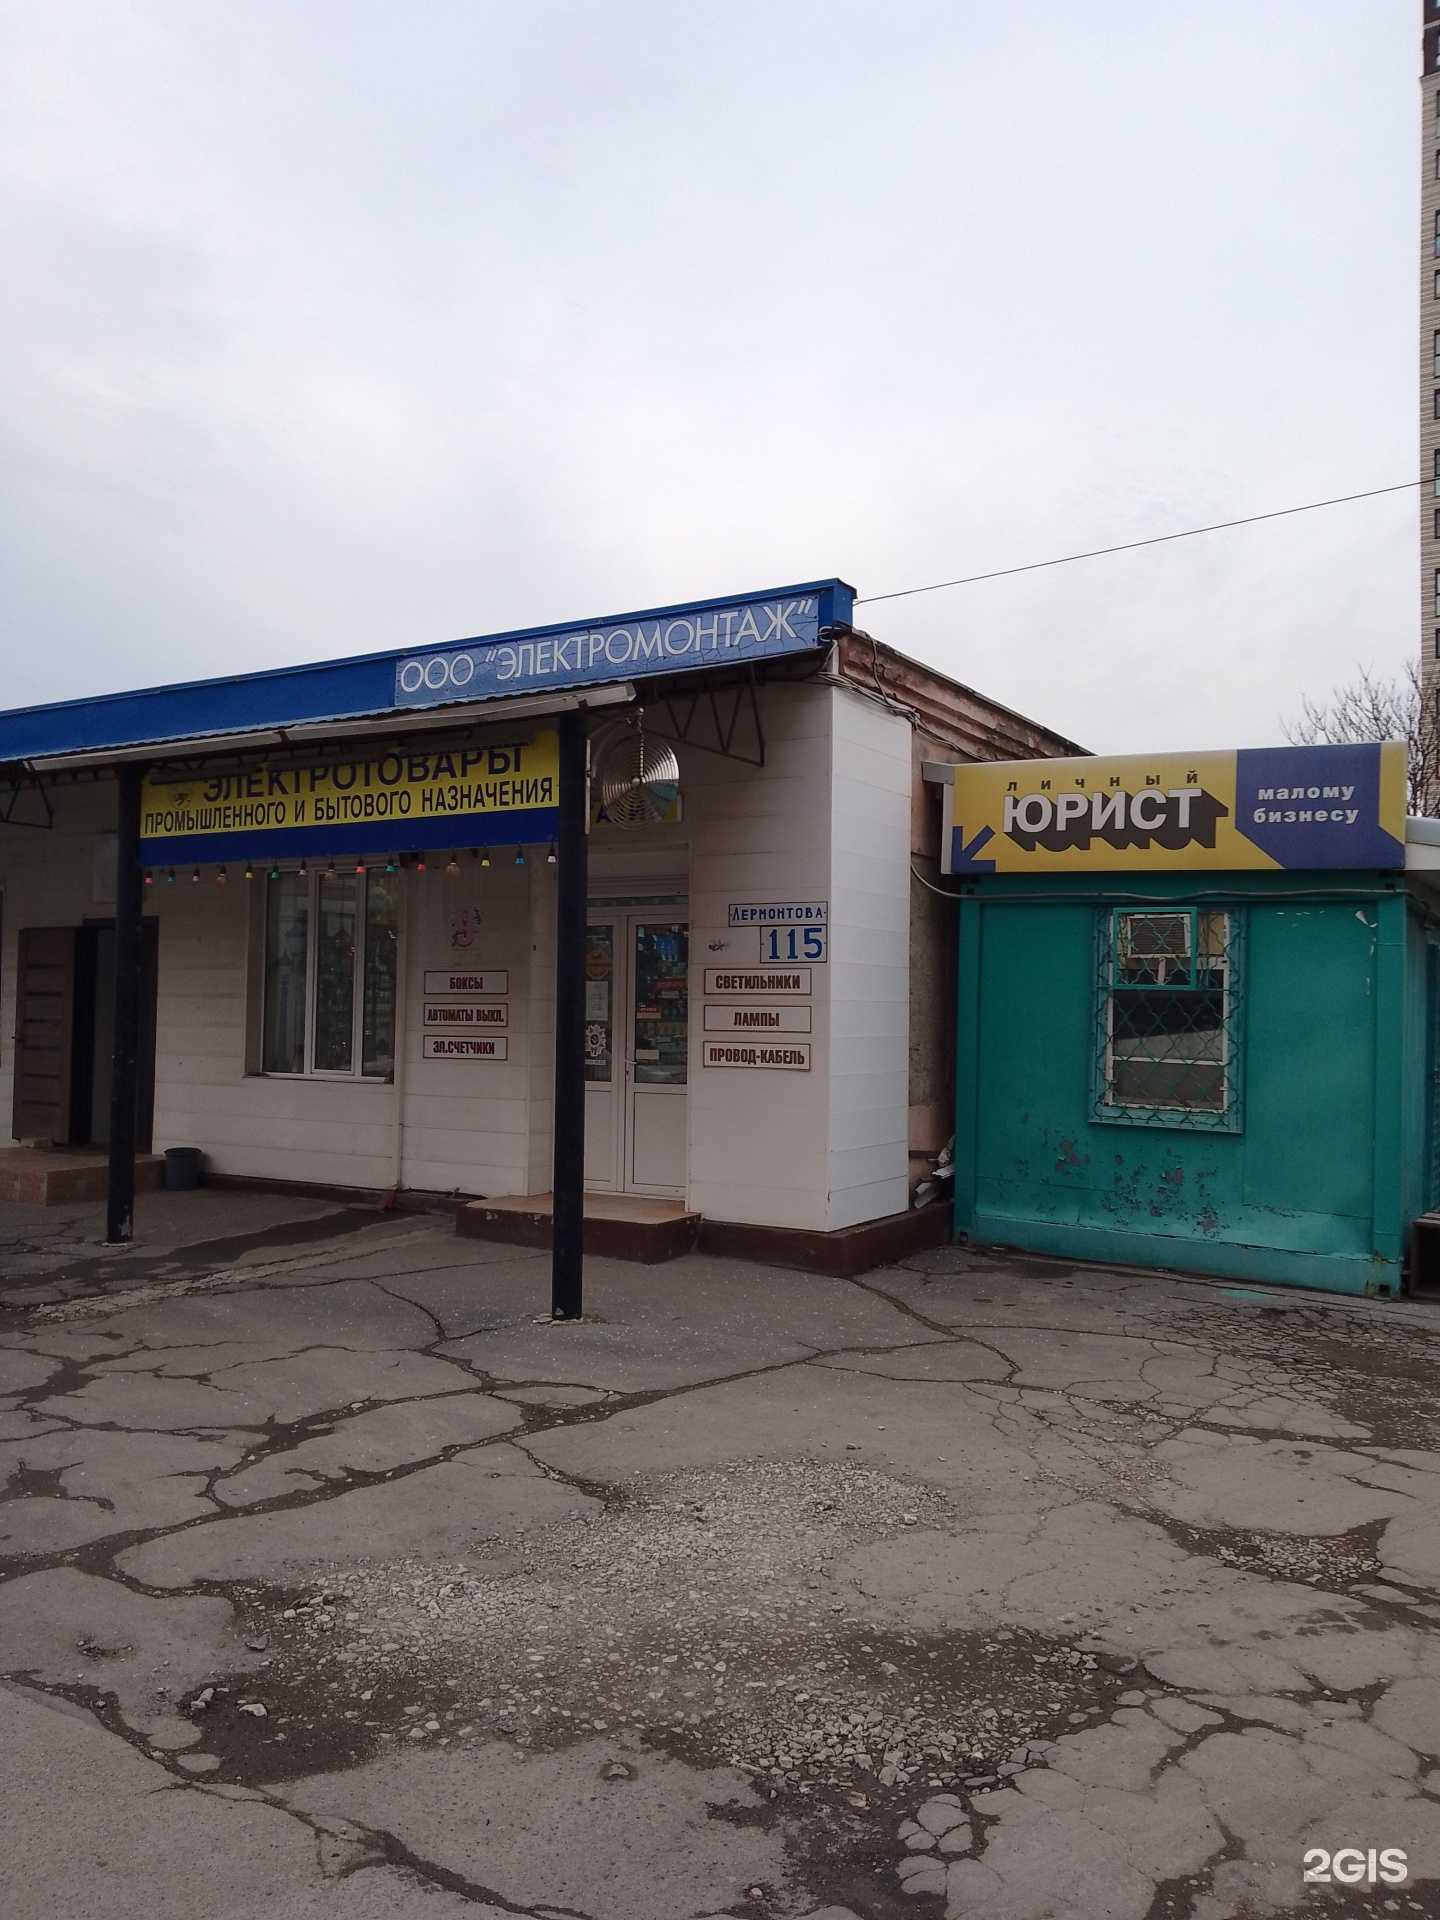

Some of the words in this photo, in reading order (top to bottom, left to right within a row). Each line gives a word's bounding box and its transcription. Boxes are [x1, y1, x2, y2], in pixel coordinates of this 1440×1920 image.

[401, 654, 474, 693] ООО
[1008, 770, 1198, 791] личный
[1258, 785, 1355, 800] малому
[145, 802, 285, 833] ПРОМЫШЛЕННОГО
[295, 800, 304, 822] И
[315, 790, 411, 820] БЫТОВОГО
[422, 777, 552, 812] НАЗНАЧЕНИЯ
[1003, 788, 1201, 833] ЮРИСТ
[1253, 807, 1359, 823] бизнесу
[733, 908, 823, 920] ЛЕРМОНТОВА
[769, 928, 823, 959] 115
[450, 978, 483, 989] БОКСЫ
[716, 975, 800, 989] СВЕТИЛЬНИКИ
[428, 1009, 473, 1021] АВТОМАТЫ
[734, 1012, 780, 1026] ЛАМПЫ
[433, 1041, 495, 1054] ЭЛ.СЧЕТЧИКИ
[710, 1048, 805, 1064] ПРОВОД-КАБЕЛЬ
